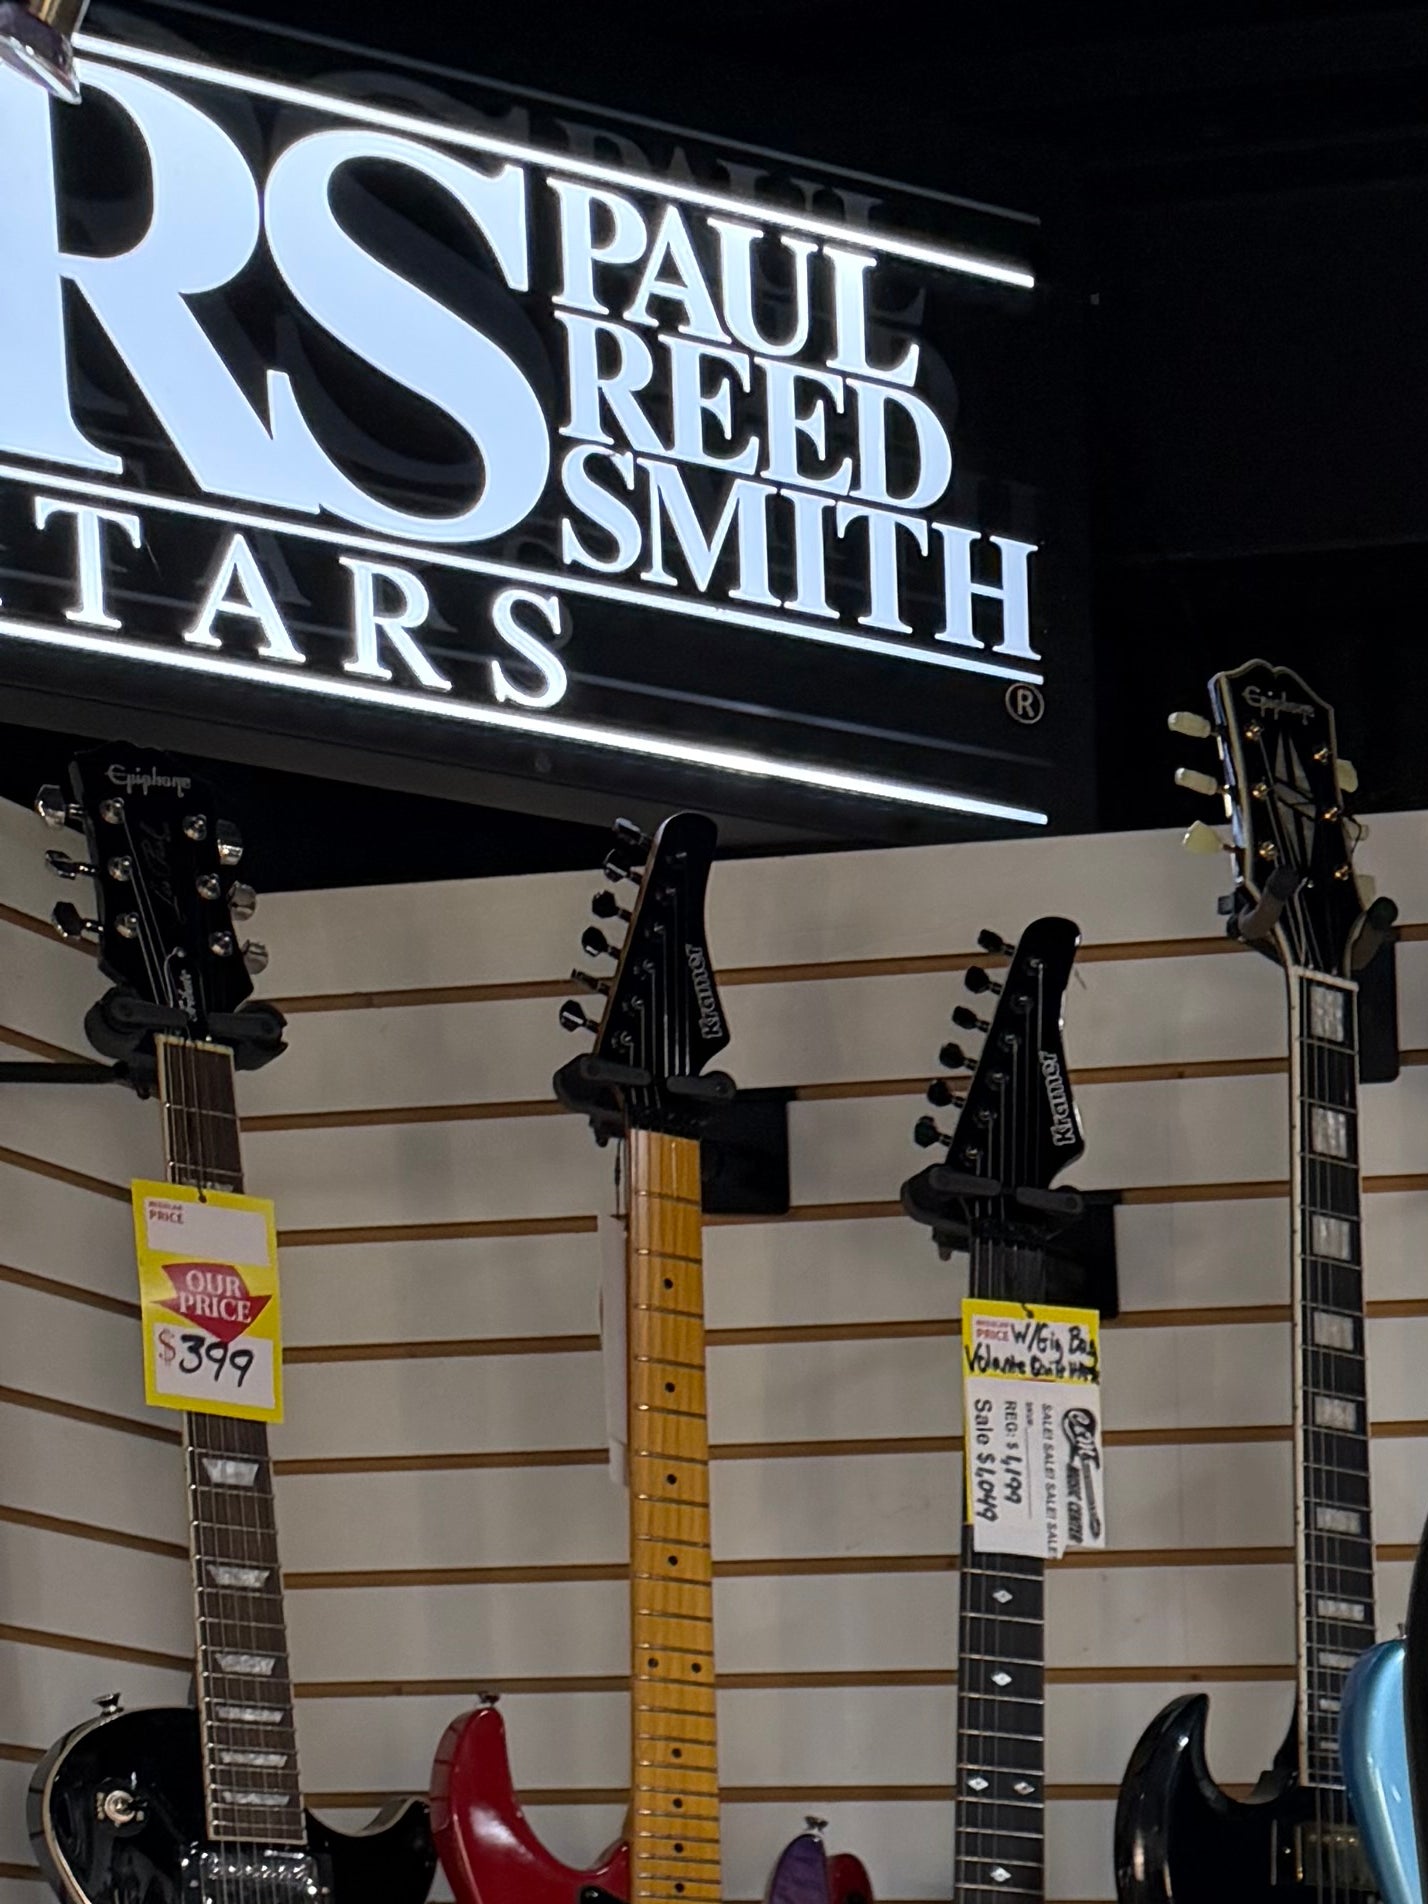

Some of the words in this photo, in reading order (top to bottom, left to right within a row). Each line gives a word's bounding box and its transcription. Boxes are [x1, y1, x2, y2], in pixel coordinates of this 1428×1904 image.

[548, 174, 920, 387] PAUL
[554, 309, 954, 513] REED
[560, 445, 1044, 662] SMITH
[105, 764, 192, 797] Epiphone
[685, 943, 722, 1038] Kramer
[1038, 1050, 1076, 1146] Kramer
[148, 1210, 184, 1225] PRICE
[179, 1291, 252, 1323] PRICE
[186, 1270, 241, 1298] OUR
[158, 1328, 254, 1388] $399
[976, 1328, 1009, 1342] PRICE
[974, 1398, 994, 1446] Sale
